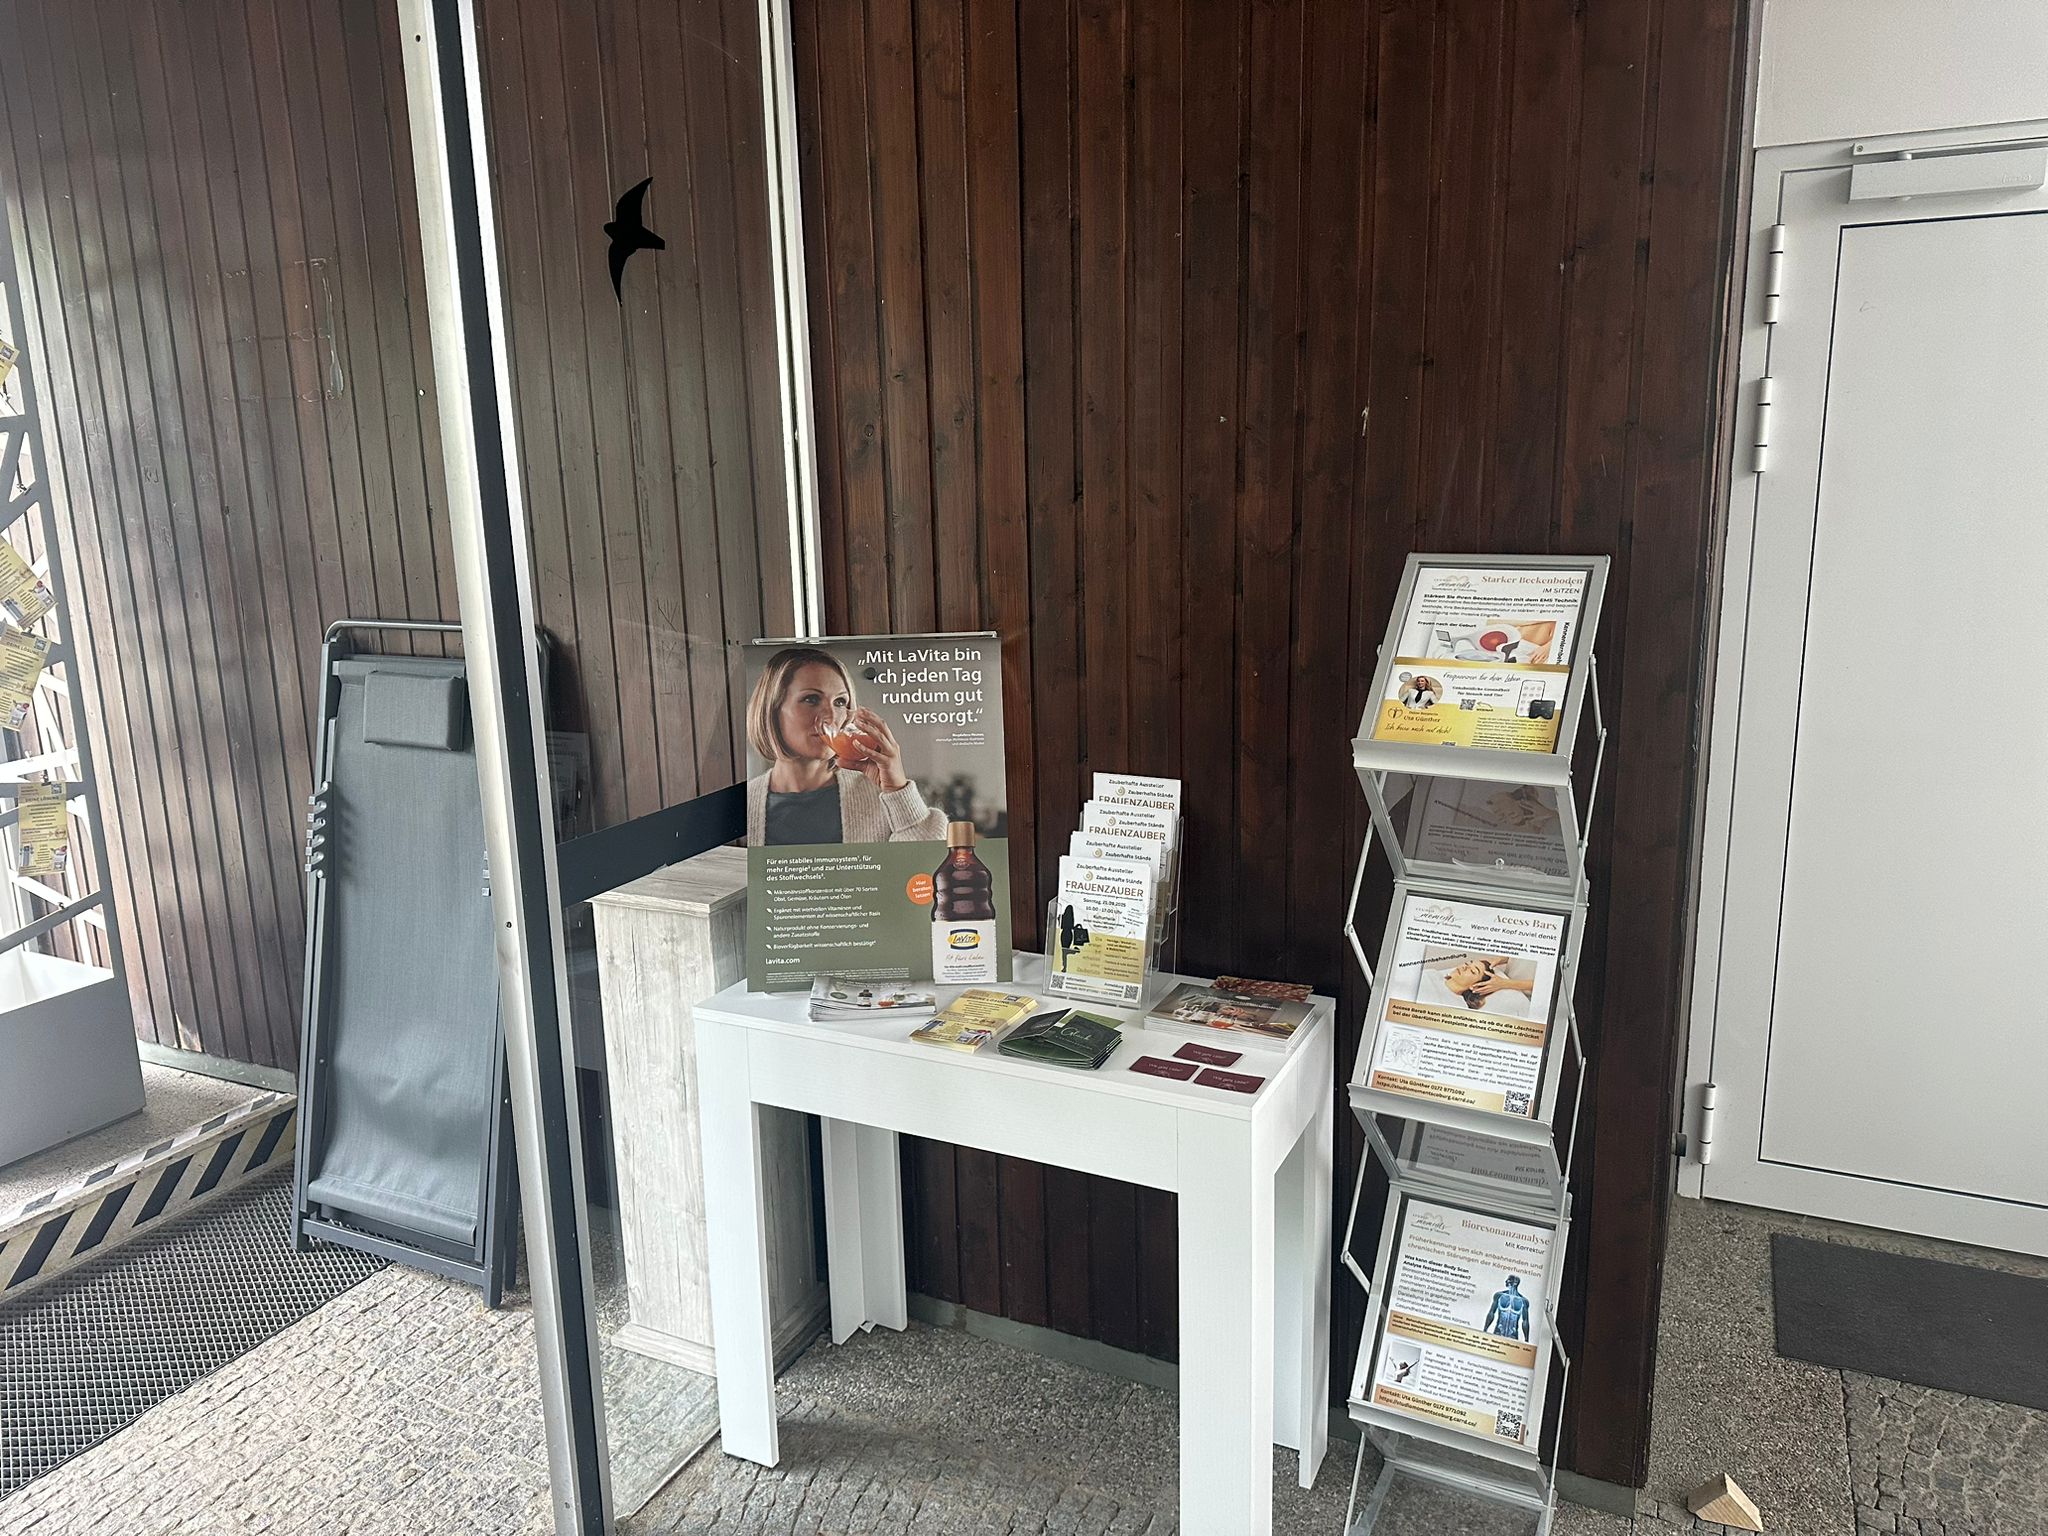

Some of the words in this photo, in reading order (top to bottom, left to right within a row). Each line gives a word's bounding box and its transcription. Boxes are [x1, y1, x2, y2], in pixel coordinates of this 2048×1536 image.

[1482, 575, 1517, 583] Starker
[1519, 576, 1583, 585] Beckenboden
[898, 649, 950, 663] LaVita
[954, 648, 981, 661] bin
[900, 668, 949, 687] jeden
[952, 667, 982, 685] Tag
[882, 688, 949, 704] rundum
[954, 688, 983, 706] gut
[1098, 796, 1175, 810] FRAUENZAUBER
[1089, 826, 1166, 840] FRAUENZAUBER
[1105, 851, 1134, 859] Zauberhafte
[836, 863, 881, 871] Unterstützung
[1076, 863, 1107, 871] Zauberhafte
[1065, 880, 1144, 897] FRAUENZAUBER
[1494, 914, 1530, 927] Access
[1532, 919, 1557, 931] Bars
[1502, 928, 1517, 936] Kopf
[1518, 930, 1537, 938] zuviel
[1398, 953, 1467, 968] Kennenlernbehandlung
[1409, 1080, 1430, 1089] Günther
[1462, 1219, 1550, 1246] Bioresonanzanalyse
[1409, 1234, 1456, 1251] Früherkennung
[1470, 1248, 1483, 1256] sich
[1485, 1252, 1529, 1267] anbahnenden
[1530, 1262, 1544, 1270] und
[1516, 1243, 1545, 1255] Korrektur
[1403, 1261, 1422, 1269] Analyse
[1407, 1242, 1445, 1256] chronischen
[1446, 1250, 1479, 1264] Störungen
[1492, 1262, 1542, 1278] Körperfunktion
[1401, 1393, 1410, 1401] Uta
[1411, 1396, 1432, 1406] Günther
